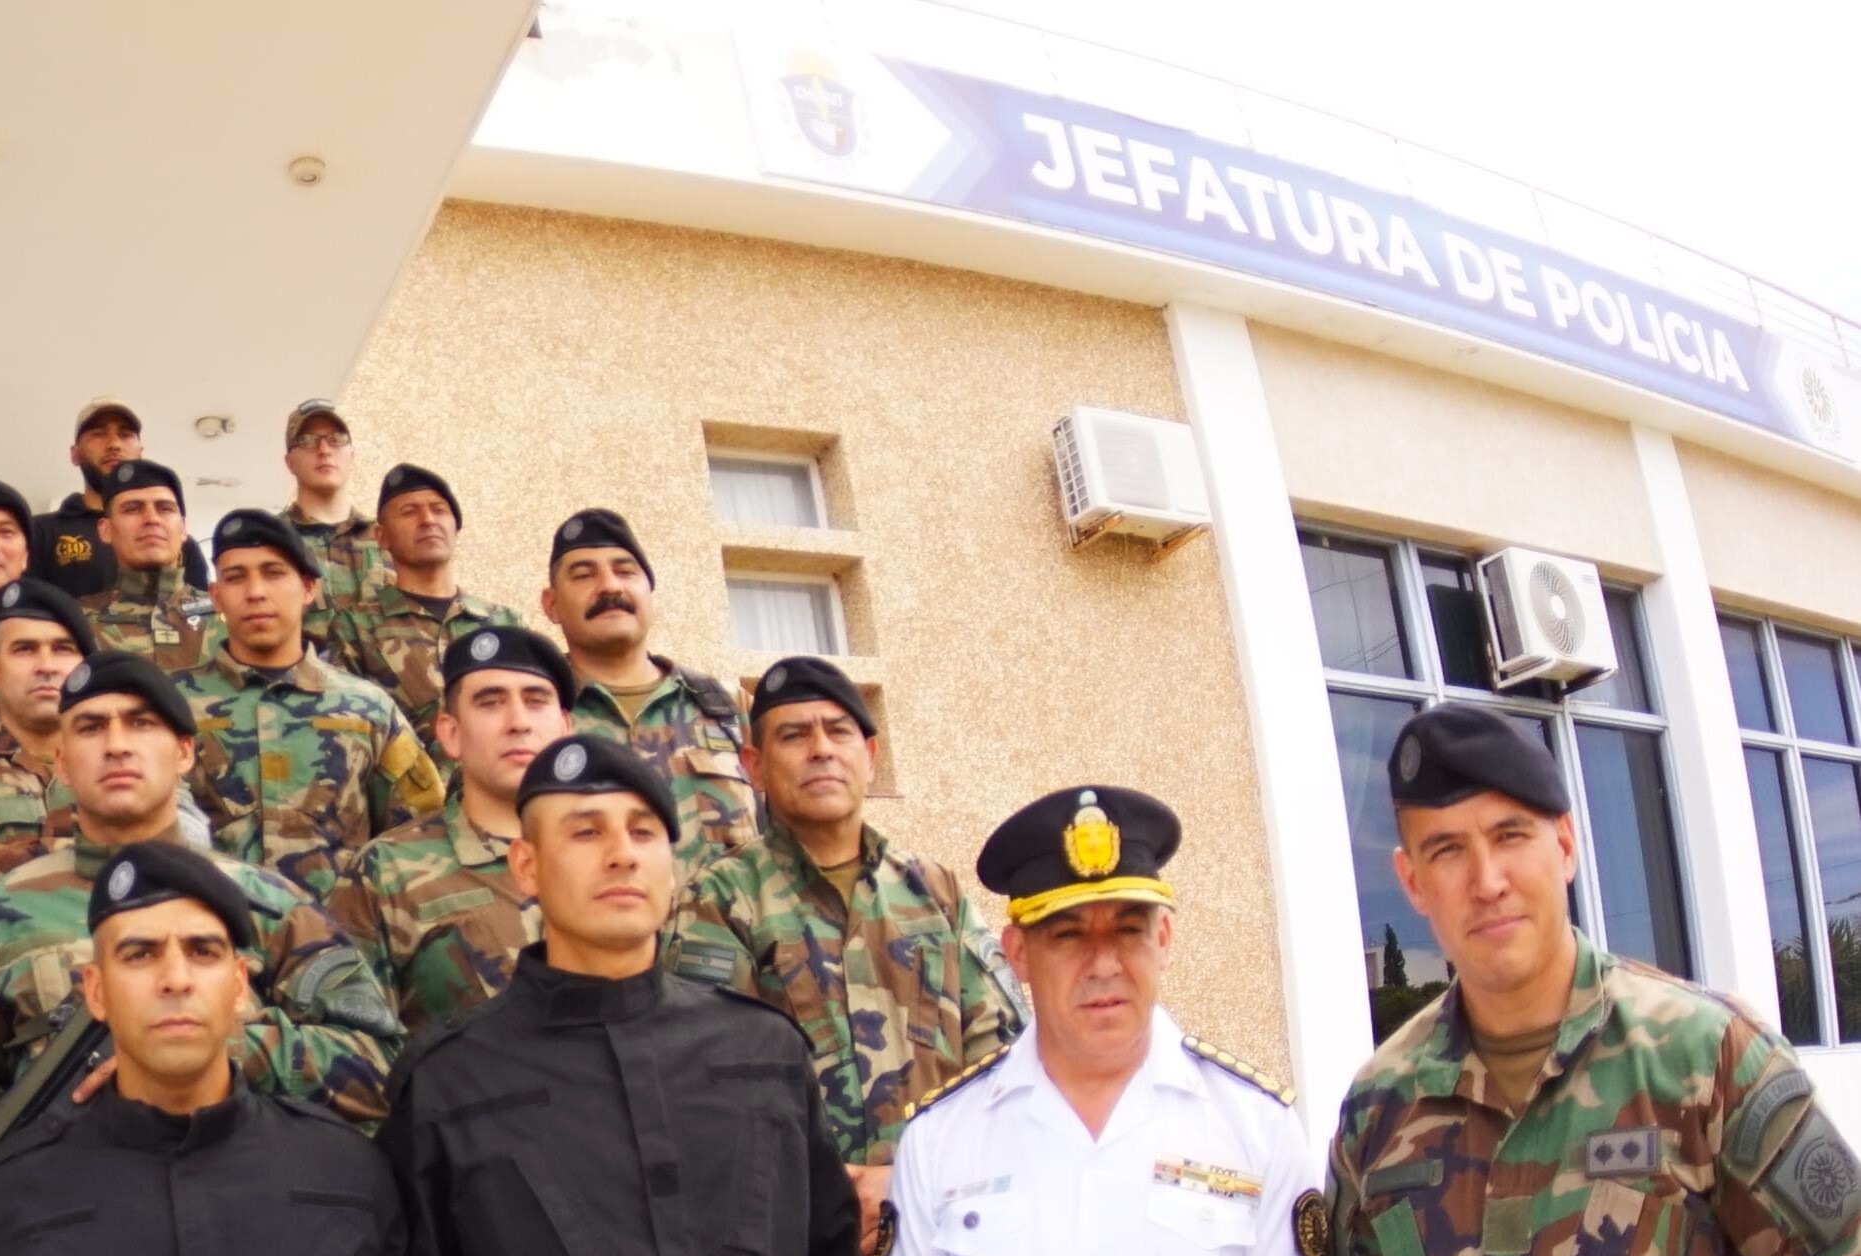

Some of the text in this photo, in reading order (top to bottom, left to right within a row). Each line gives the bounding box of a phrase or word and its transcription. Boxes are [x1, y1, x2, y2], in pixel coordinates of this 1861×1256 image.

[1022, 112, 1750, 393] JEFATURA DE POLICIA
